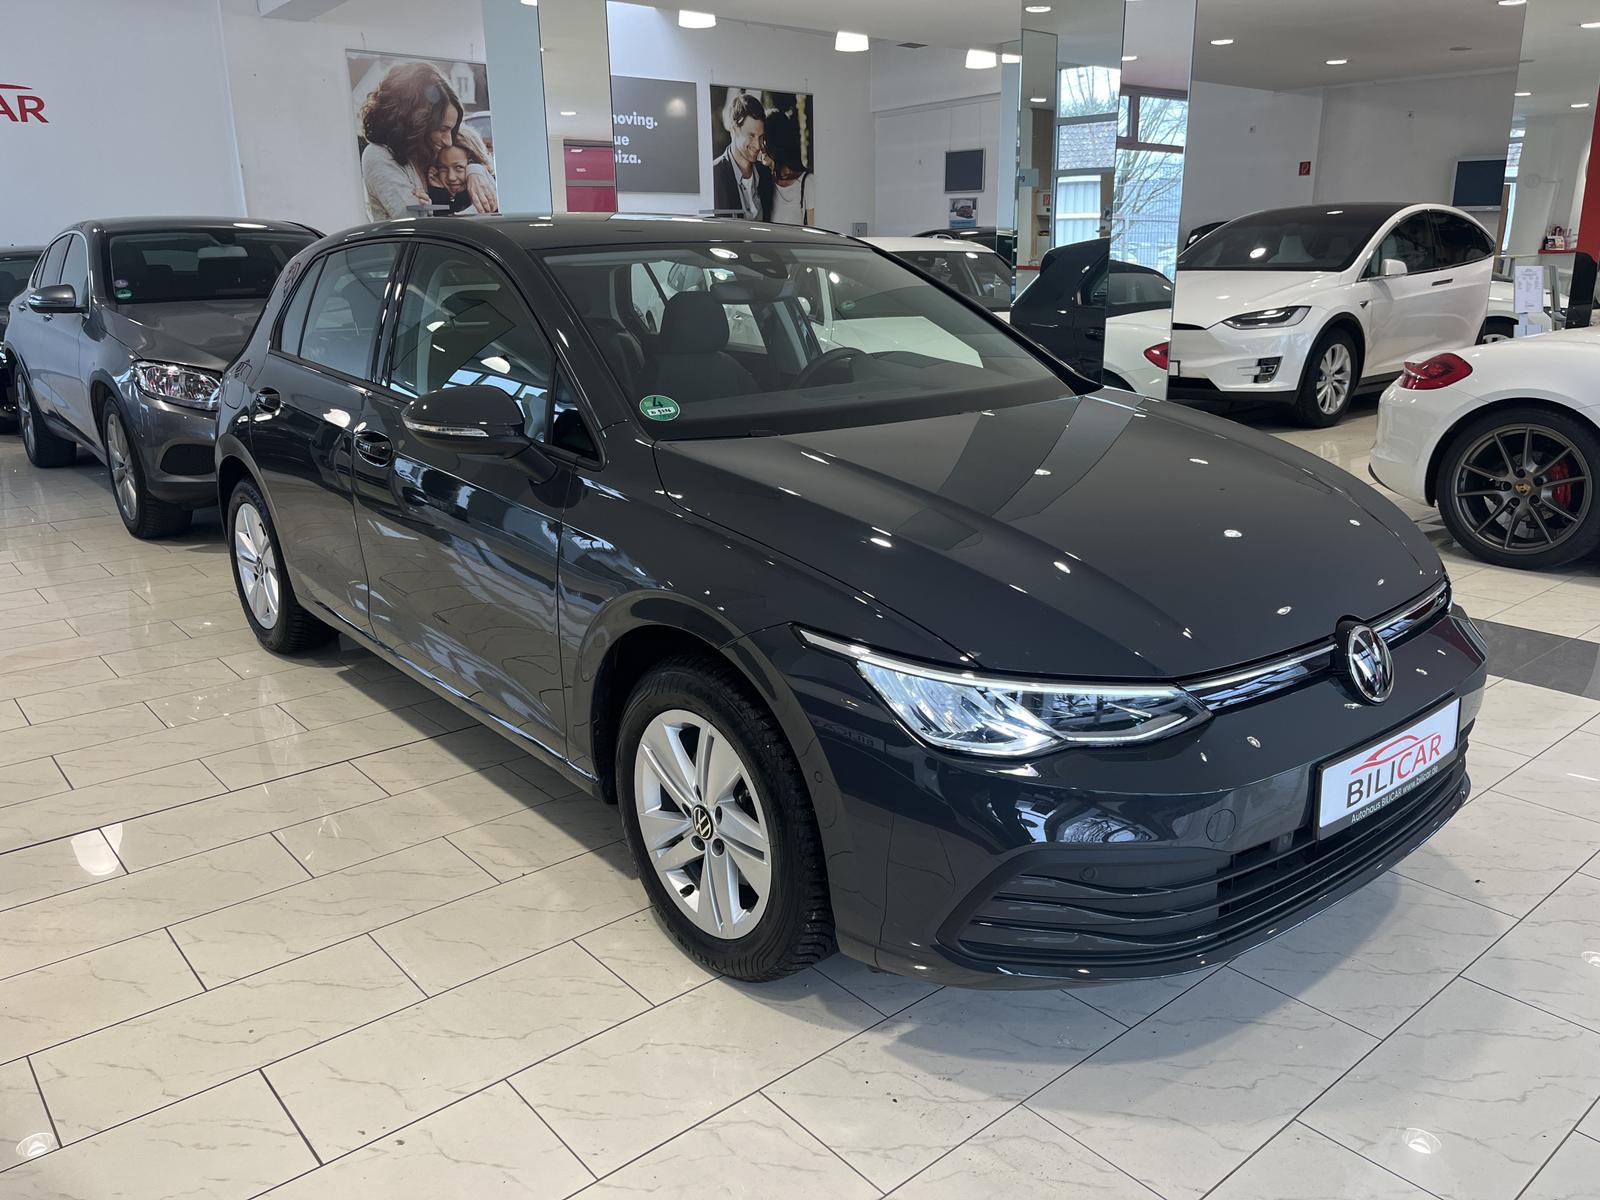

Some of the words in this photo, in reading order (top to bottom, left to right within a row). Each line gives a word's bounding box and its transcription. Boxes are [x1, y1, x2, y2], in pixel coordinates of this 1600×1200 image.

[1346, 735, 1441, 808] BILICAR
[1351, 801, 1381, 823] Autohaus
[1381, 787, 1402, 807] BILICAR
[1402, 765, 1438, 795] www.bilicar.de
